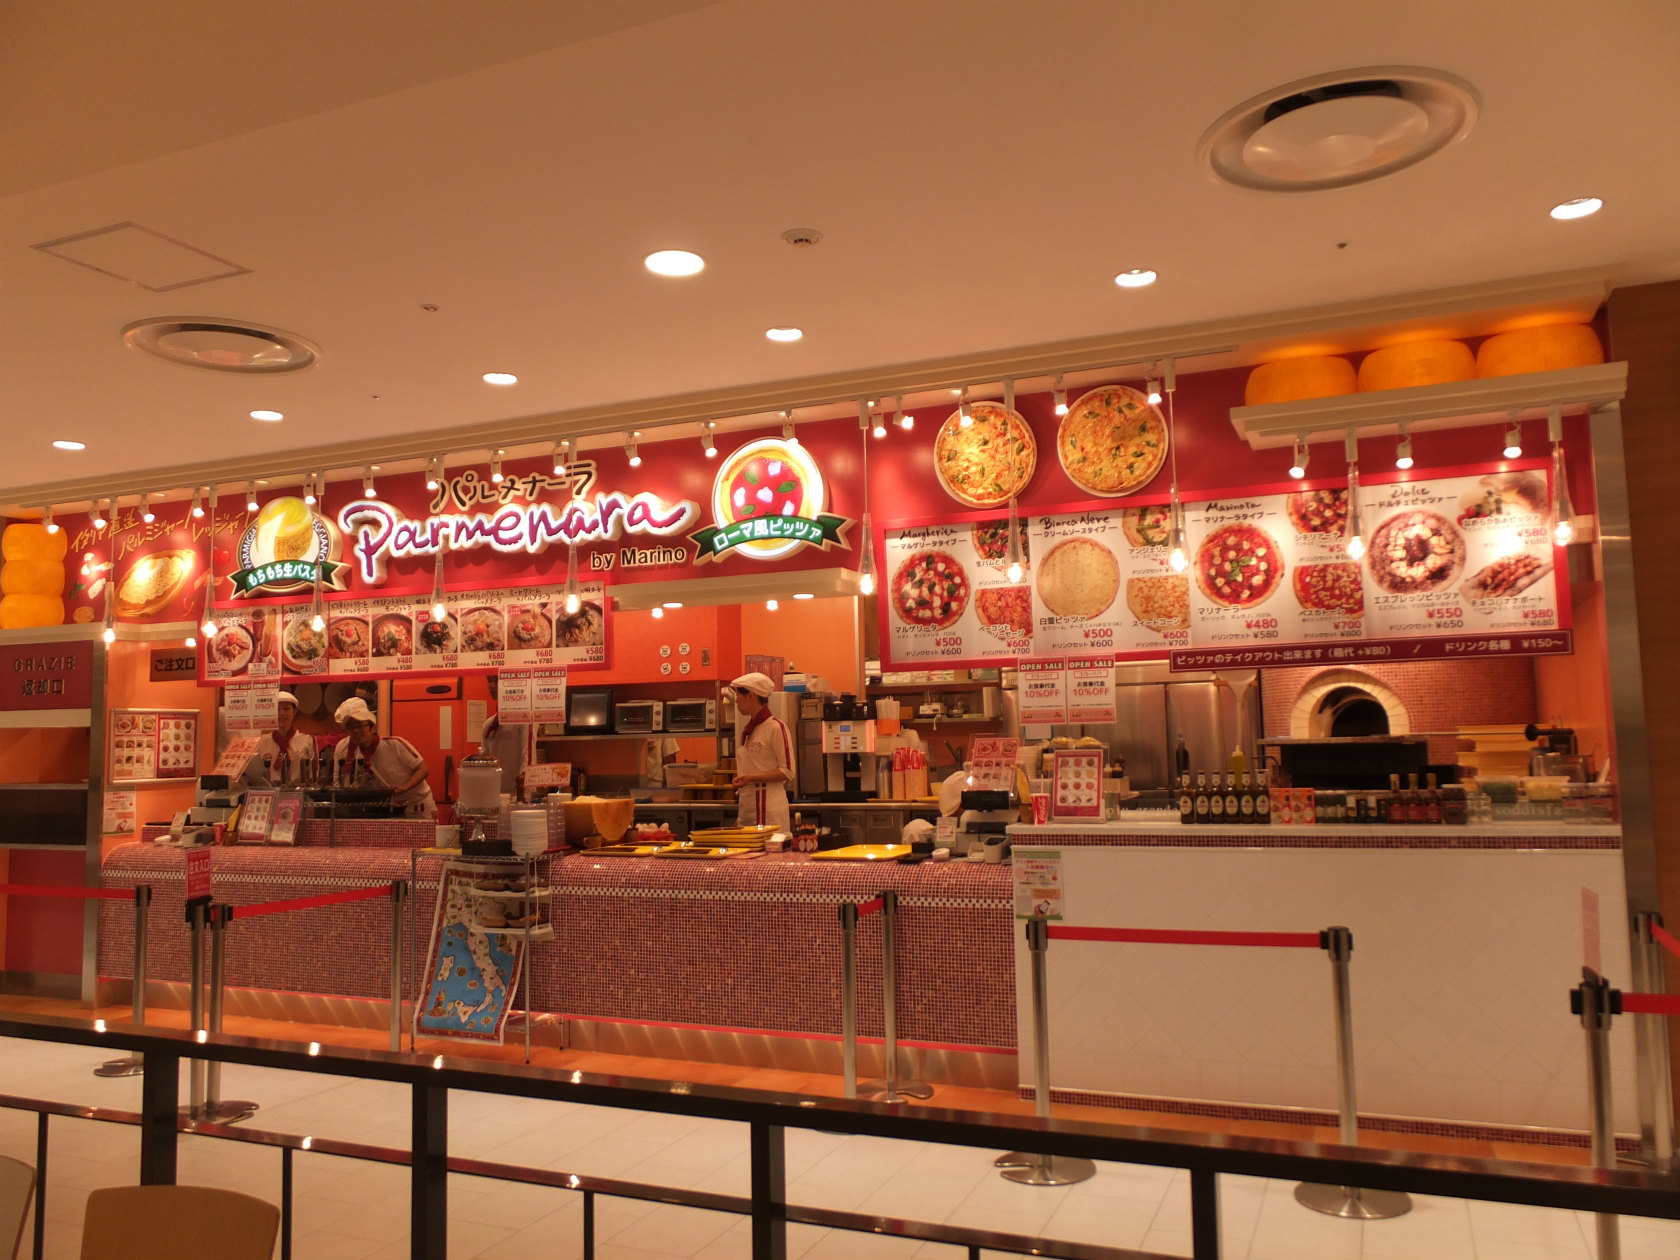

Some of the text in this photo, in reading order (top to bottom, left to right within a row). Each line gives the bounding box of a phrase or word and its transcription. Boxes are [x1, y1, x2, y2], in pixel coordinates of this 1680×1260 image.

[431, 462, 595, 511] パルメナーラ
[1204, 511, 1264, 523] マリナーラタイプ
[341, 492, 690, 580] Parmenara
[713, 518, 822, 551] ローマ風ピッツァ
[900, 526, 958, 541] Margherita
[901, 538, 957, 550] マルゲリータタイプ
[591, 546, 686, 570] by Marino
[1197, 606, 1240, 615] マリナーラ
[1426, 607, 1463, 619] ¥550
[1522, 608, 1554, 619] ¥580
[1132, 617, 1180, 627] スイートコーン
[1245, 618, 1278, 630] ¥480
[1334, 620, 1362, 630] ¥700
[1436, 619, 1464, 629] ¥650
[896, 623, 938, 634] マルゲリータ
[1083, 628, 1113, 639] ¥500
[1162, 630, 1189, 640] ¥600
[1253, 630, 1279, 640] ¥580
[935, 636, 962, 647] ¥500
[1006, 638, 1030, 648] ¥600
[1090, 638, 1113, 648] ¥600
[1169, 639, 1189, 647] ¥700
[488, 651, 505, 660] ¥680
[536, 649, 553, 658] ¥680
[585, 646, 604, 655] ¥580
[941, 646, 962, 656] ¥600
[1012, 647, 1030, 655] ¥700
[14, 655, 76, 673] GRAZIE
[153, 656, 196, 673] ご注文口
[354, 658, 370, 667] ¥580
[397, 656, 413, 664] ¥480
[1021, 662, 1063, 671] OPEN SALE
[22, 678, 66, 697] 返却口
[1073, 687, 1110, 696] 10%OFF
[1024, 689, 1060, 698] 10%OFF
